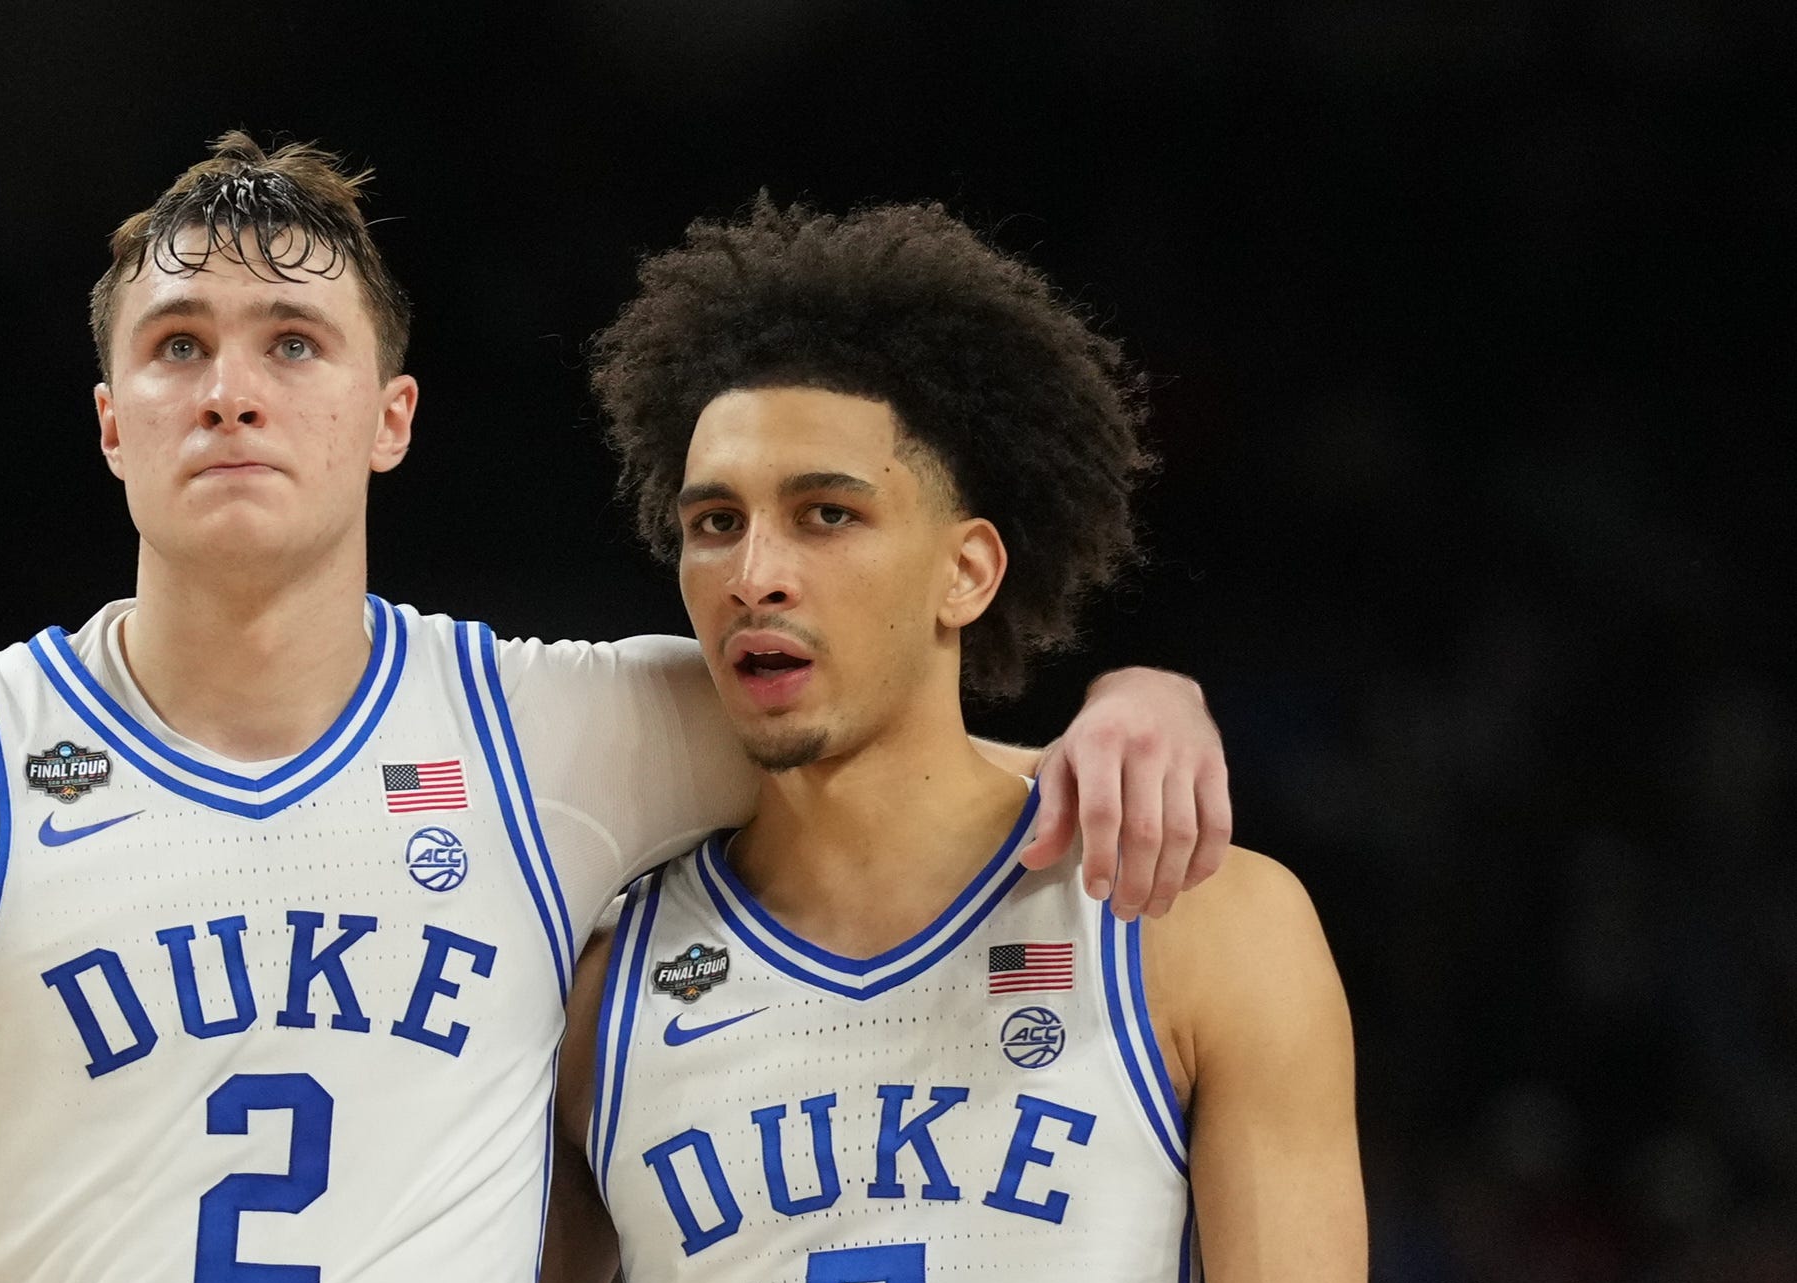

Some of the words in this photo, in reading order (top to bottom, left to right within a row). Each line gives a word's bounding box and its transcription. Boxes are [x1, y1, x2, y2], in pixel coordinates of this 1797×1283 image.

[29, 763, 68, 778] FINAL
[70, 759, 108, 776] FOUR
[414, 848, 463, 862] ACC
[658, 965, 694, 981] FINAL
[696, 957, 727, 976] FOUR
[41, 910, 497, 1079] DUKE
[1008, 1025, 1062, 1041] ACC
[642, 1084, 1097, 1257] DUKE
